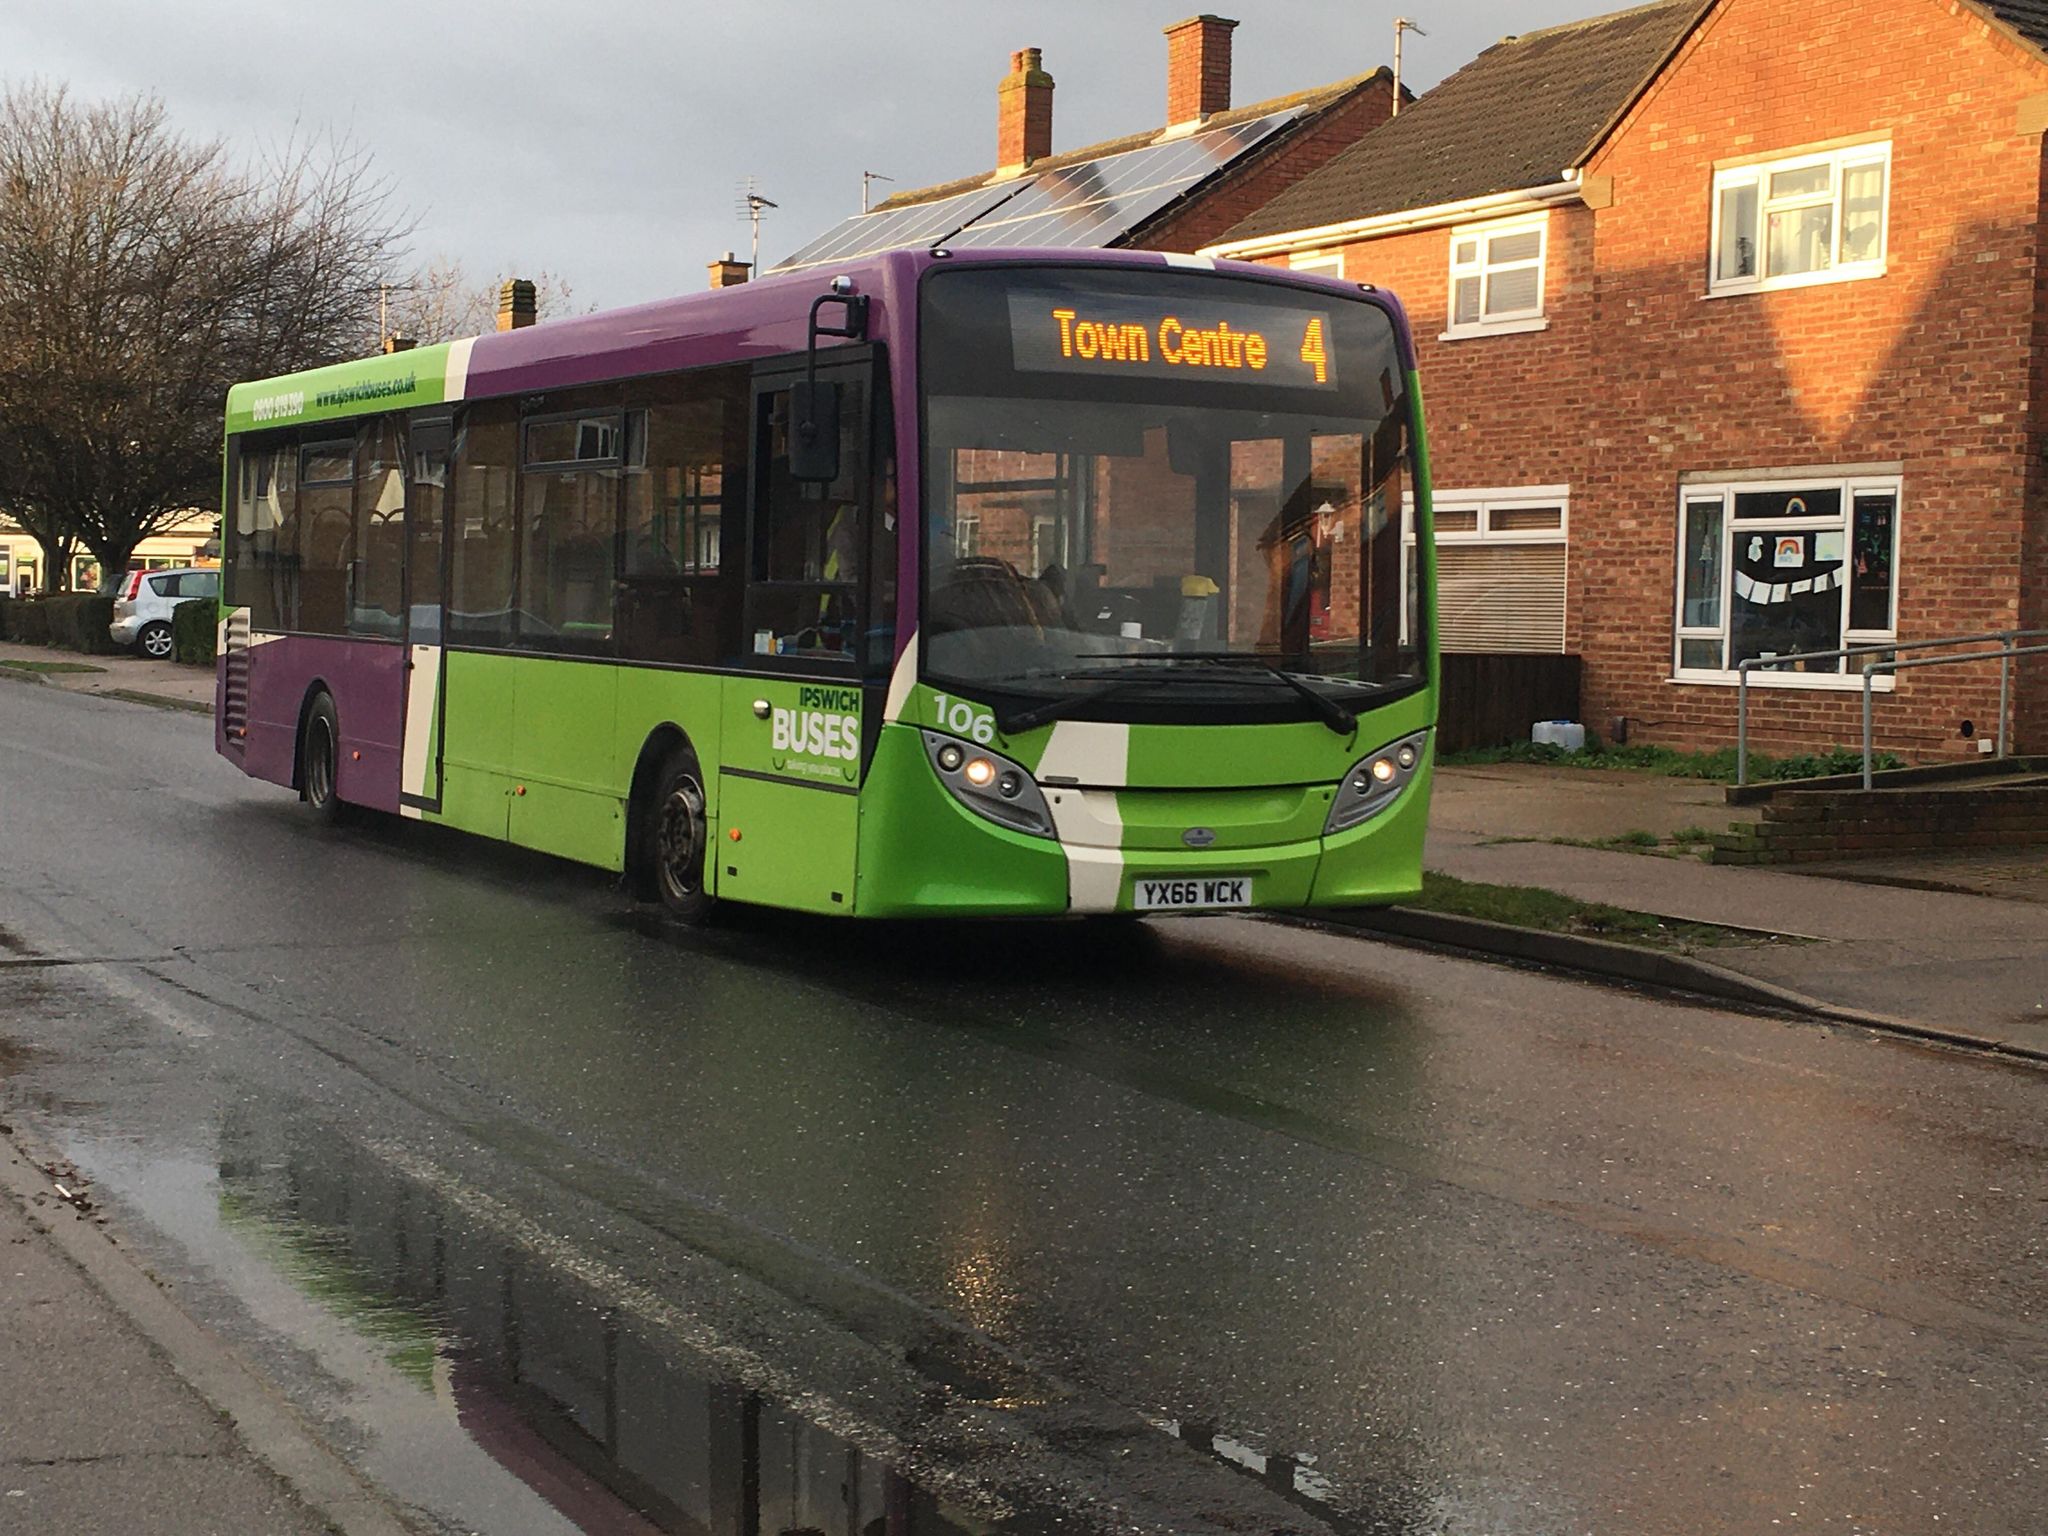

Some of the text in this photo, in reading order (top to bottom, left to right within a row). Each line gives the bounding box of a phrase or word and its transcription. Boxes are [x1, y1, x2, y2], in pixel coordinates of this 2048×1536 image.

[1053, 309, 1327, 383] Town Centre 4
[800, 687, 860, 712] IPSWICH
[934, 695, 994, 745] 106
[772, 708, 859, 761] BUSES
[1144, 880, 1244, 905] YX66 WCK
